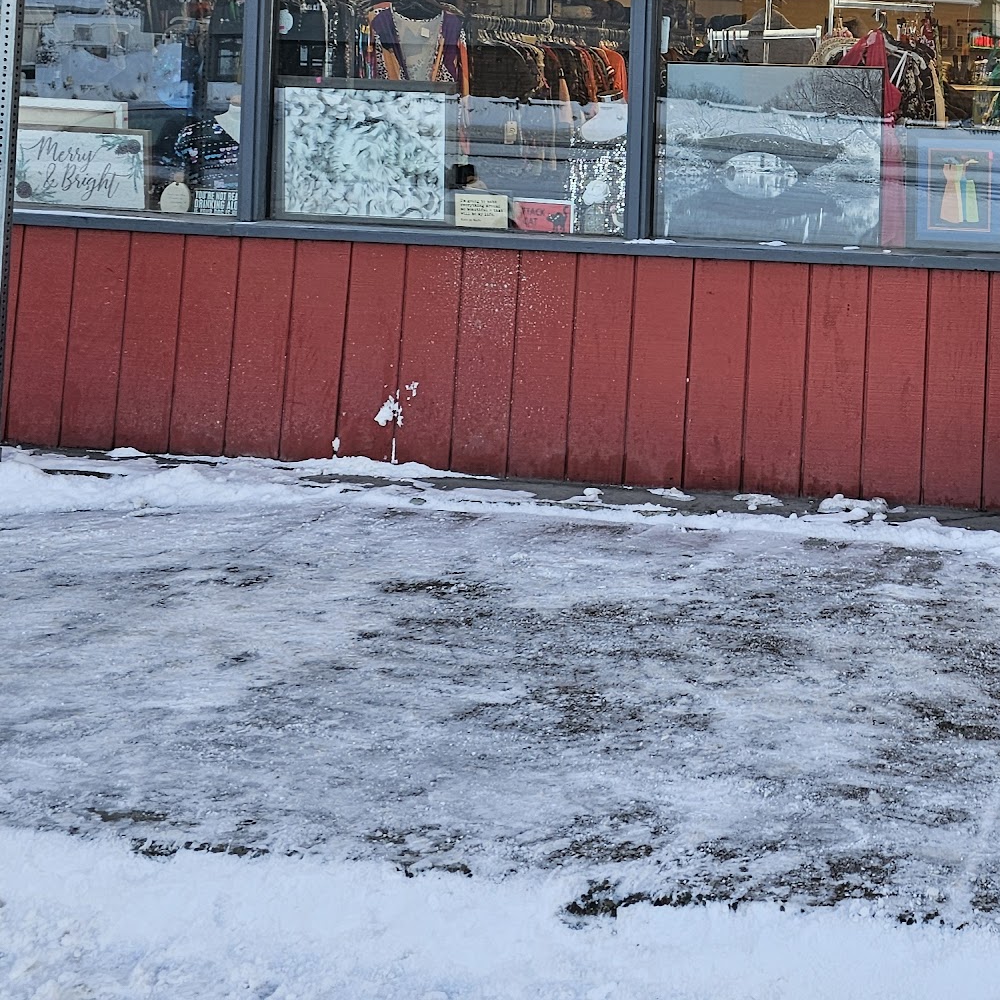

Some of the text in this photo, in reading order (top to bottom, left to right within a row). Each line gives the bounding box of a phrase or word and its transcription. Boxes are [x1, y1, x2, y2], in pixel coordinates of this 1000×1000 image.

[25, 136, 104, 172] Merry
[43, 163, 58, 188] &
[61, 163, 131, 201] Bright
